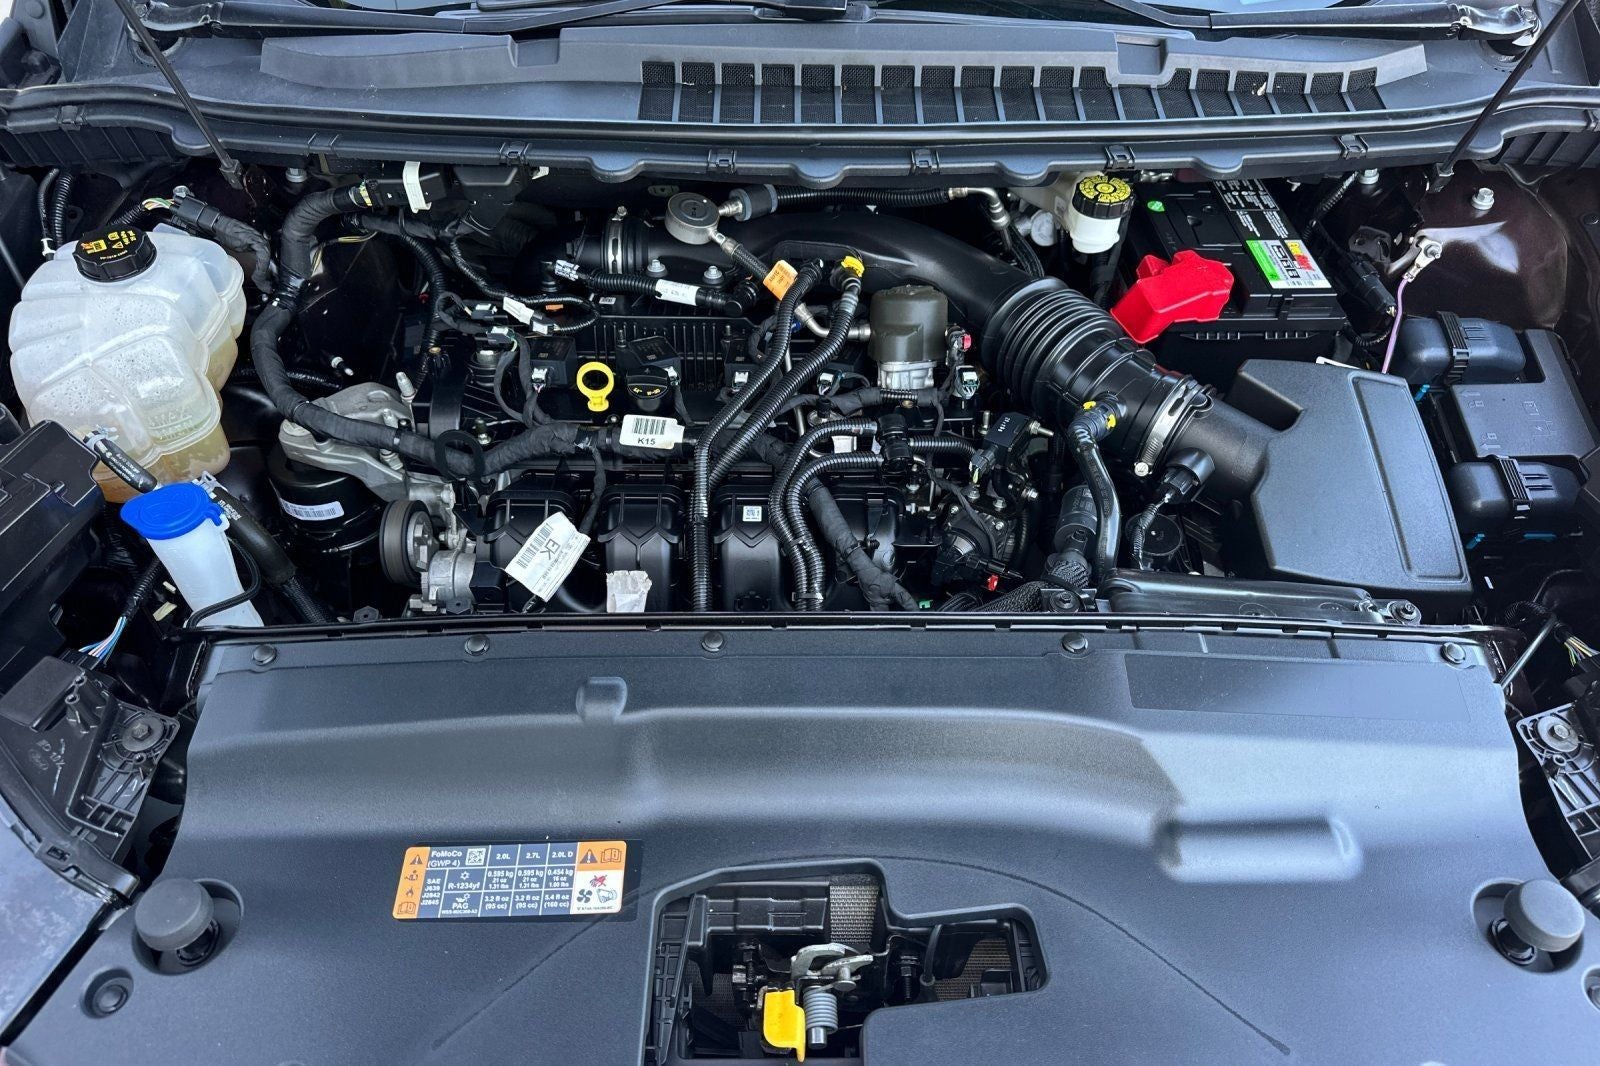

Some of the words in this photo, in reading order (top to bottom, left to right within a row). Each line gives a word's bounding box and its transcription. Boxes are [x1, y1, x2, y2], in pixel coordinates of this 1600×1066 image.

[638, 437, 656, 445] K15
[540, 539, 561, 560] EK
[428, 860, 451, 868] (GWP
[452, 859, 461, 868] 4)
[506, 870, 514, 878] kg
[536, 869, 544, 877] kg
[566, 868, 574, 876] kg
[448, 882, 480, 890] R-1234yf
